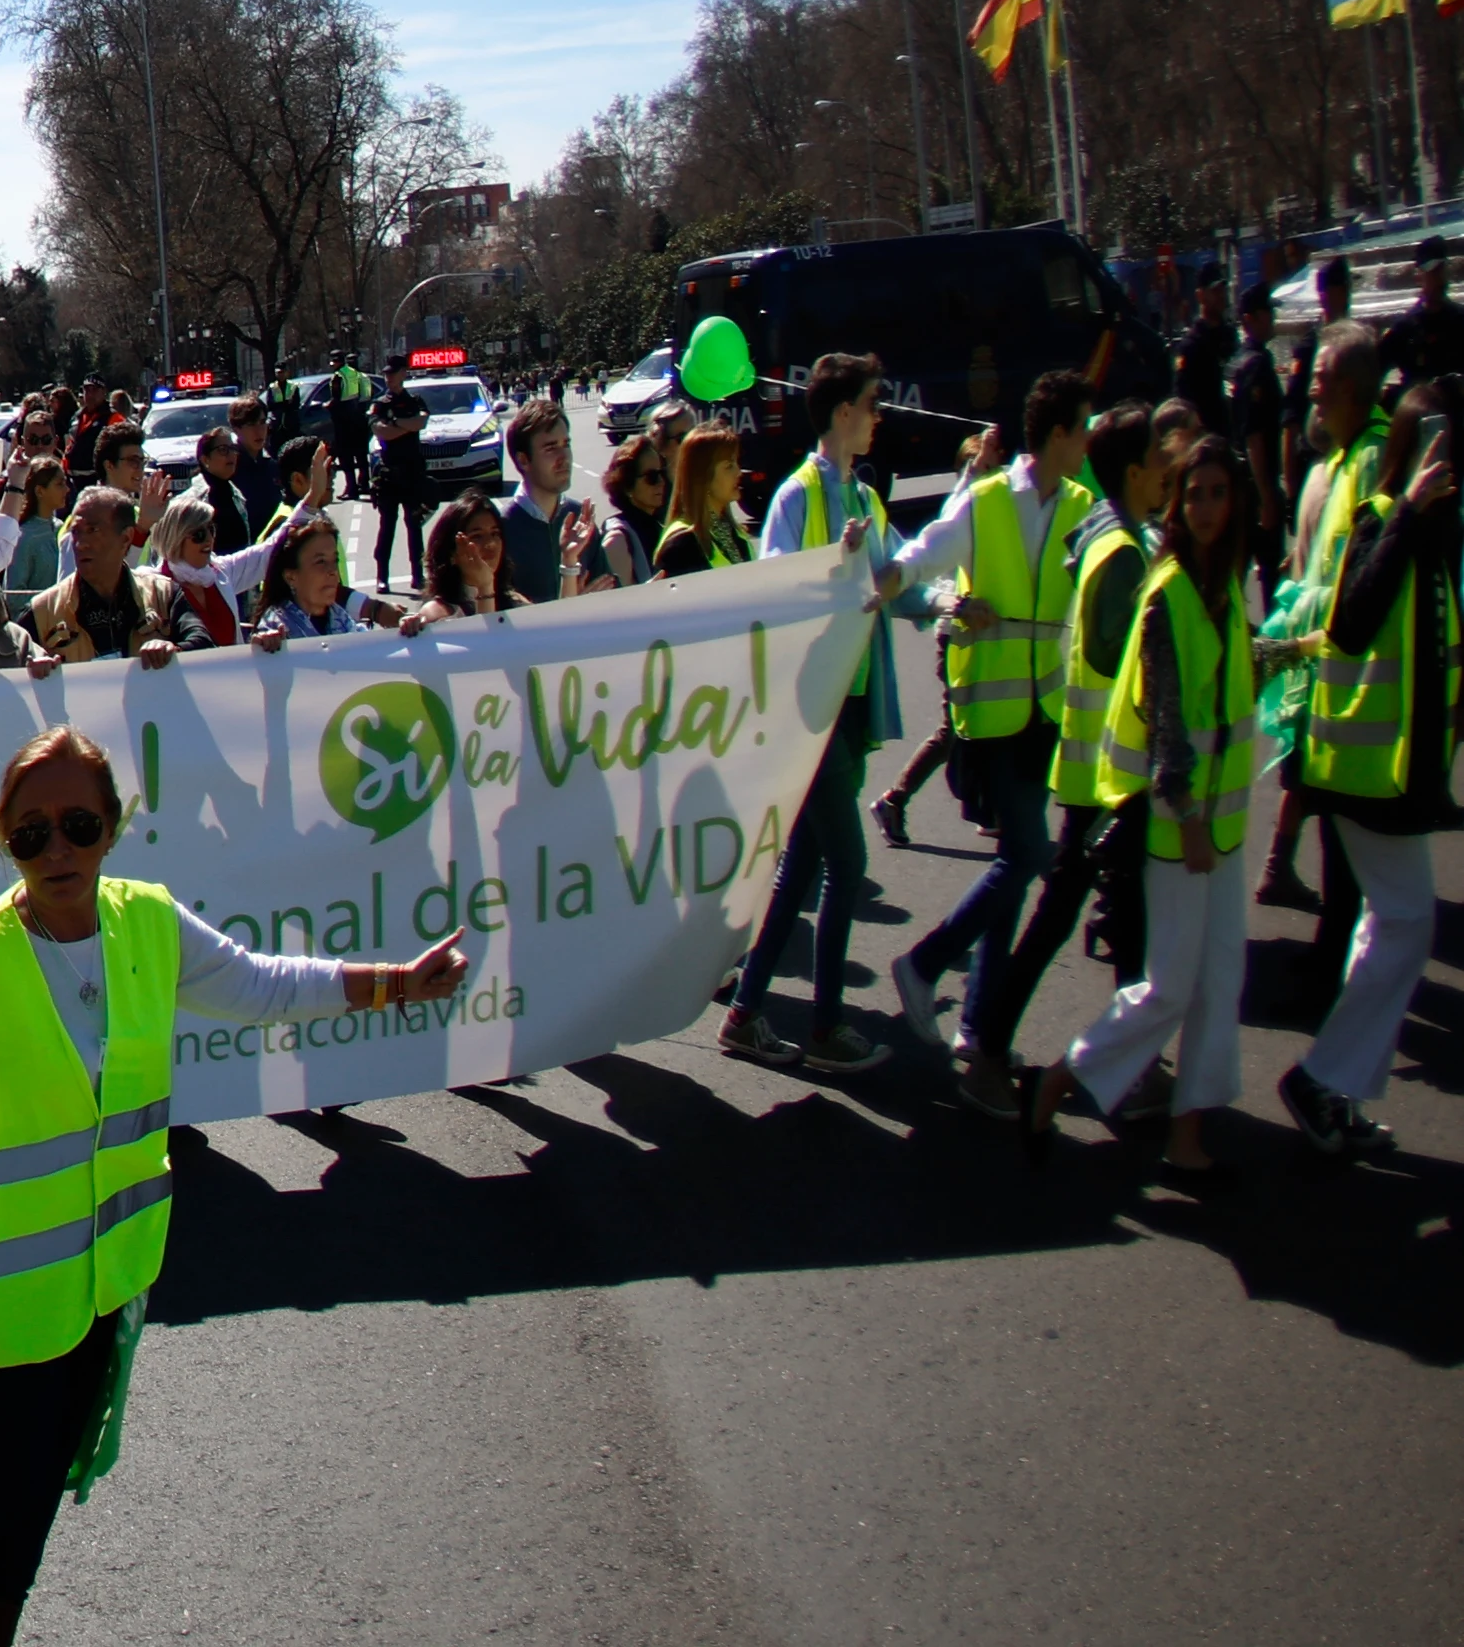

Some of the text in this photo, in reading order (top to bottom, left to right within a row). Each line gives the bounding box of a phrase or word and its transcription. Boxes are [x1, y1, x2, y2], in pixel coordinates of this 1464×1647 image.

[178, 373, 212, 388] CALLE
[411, 350, 464, 366] ATENCION
[340, 694, 511, 810] Sí a
[463, 620, 766, 788] la Vida!
[413, 861, 510, 942] de
[536, 845, 595, 924] la
[615, 805, 782, 906] VIDA
